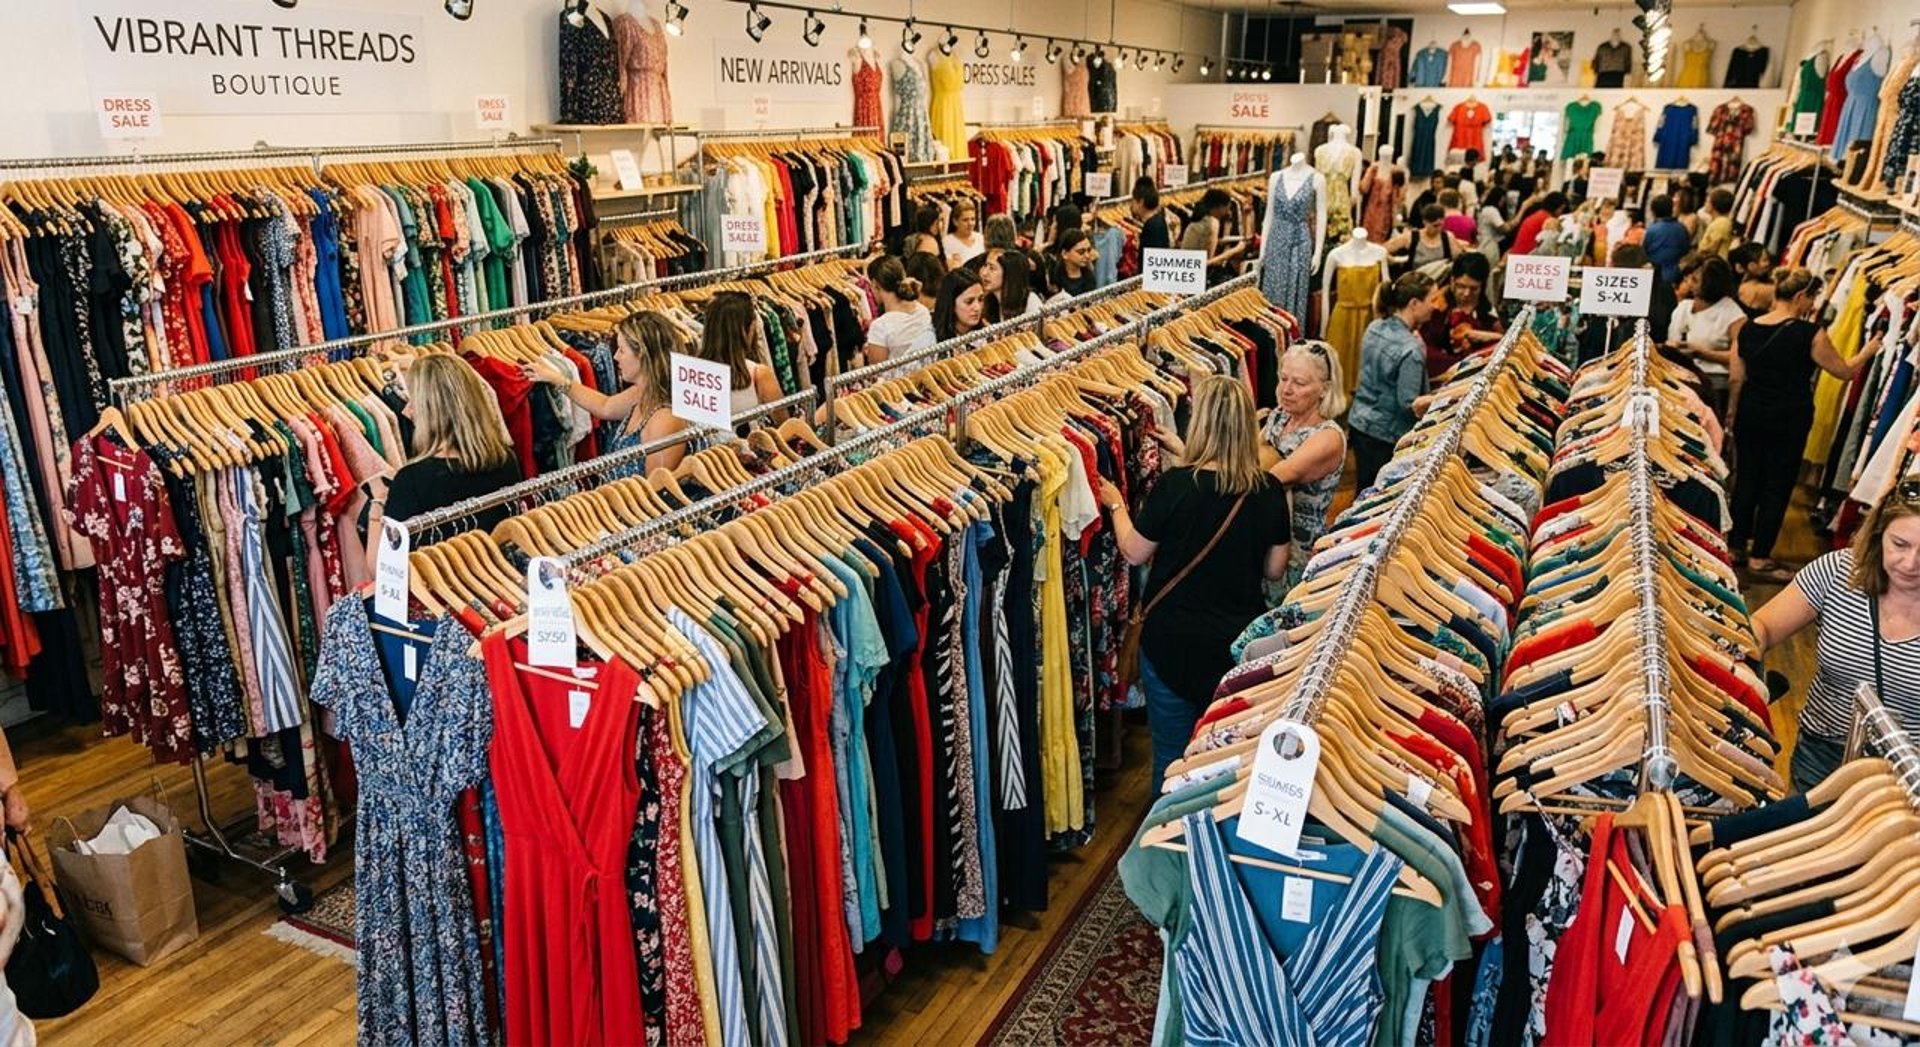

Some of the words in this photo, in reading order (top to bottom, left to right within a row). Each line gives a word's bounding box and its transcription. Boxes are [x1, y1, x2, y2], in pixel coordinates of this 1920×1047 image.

[94, 16, 263, 57] VIBRANT
[272, 27, 416, 63] THREADS
[721, 57, 763, 83] NEW
[768, 60, 841, 85] ARRIVALS
[963, 63, 1000, 85] DRESS
[1002, 65, 1035, 86] SALES
[212, 74, 342, 96] BOUTIQUE
[103, 98, 152, 111] DRESS
[1231, 104, 1269, 118] SALE
[111, 115, 150, 128] SALE
[726, 221, 760, 231] DRESS
[1147, 256, 1201, 269] SUMMER
[1514, 263, 1561, 276] DRESS
[1151, 269, 1195, 283] STYLES
[1595, 275, 1639, 288] SIZES
[1516, 278, 1553, 290] SALE
[1597, 290, 1632, 304] S-XL
[678, 365, 722, 391] DRESS
[683, 389, 718, 412] SALE
[1253, 801, 1291, 827] S-XL
